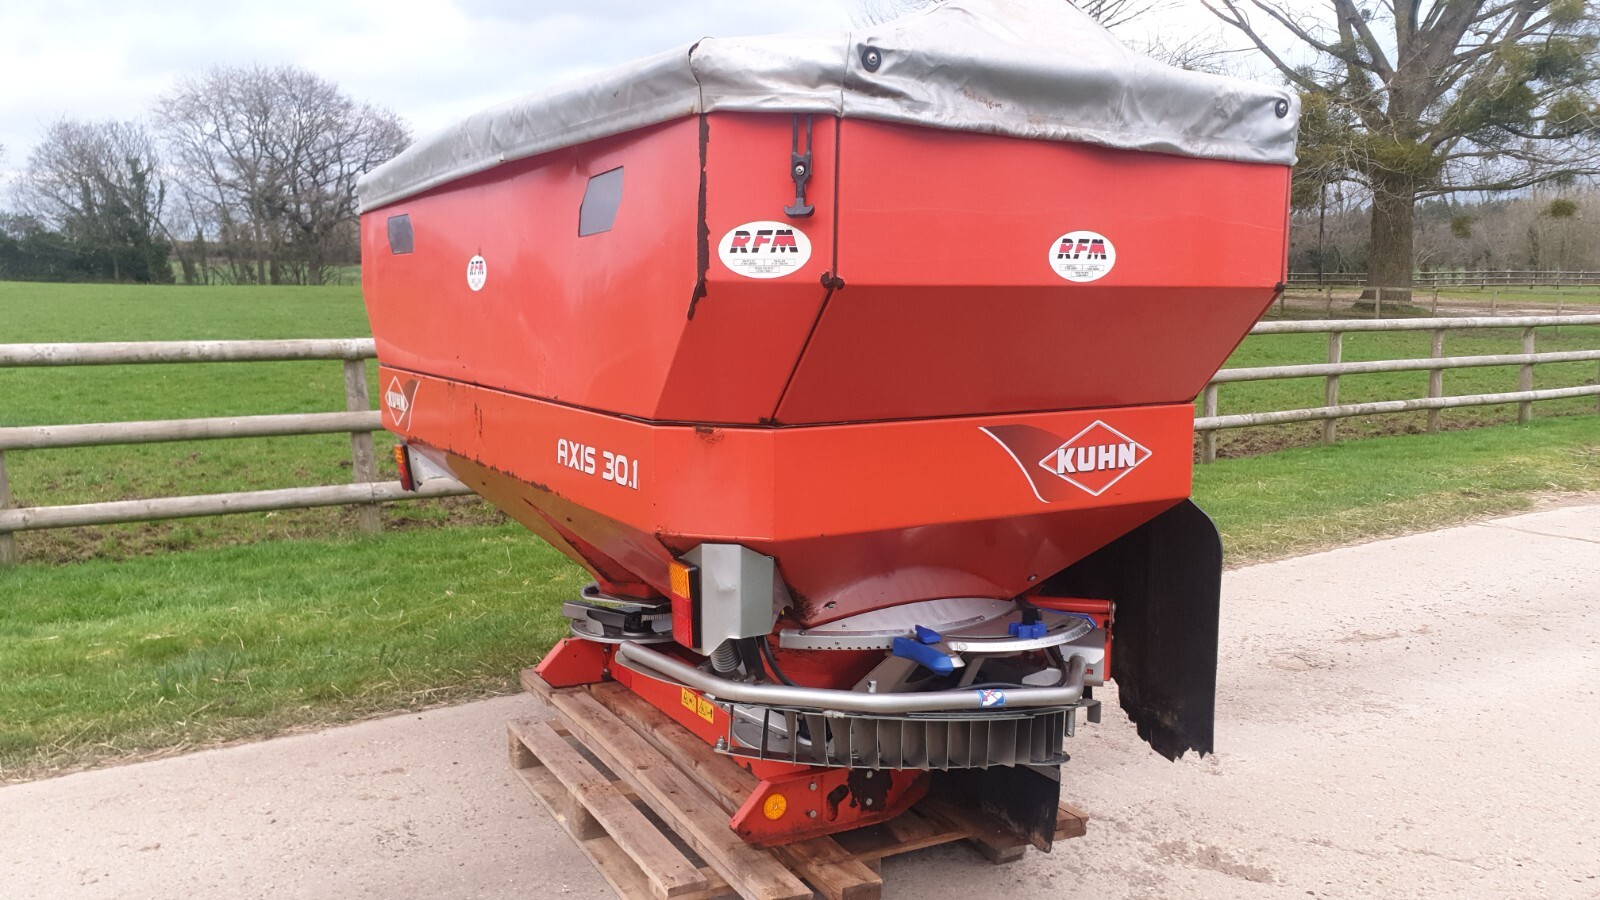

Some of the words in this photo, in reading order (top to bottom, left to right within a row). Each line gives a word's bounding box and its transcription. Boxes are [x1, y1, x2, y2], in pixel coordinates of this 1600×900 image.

[730, 229, 798, 253] RFM
[1057, 238, 1107, 260] RFM
[557, 438, 596, 475] AXIS
[602, 450, 638, 490] 30.1
[1057, 442, 1136, 474] KUHN
